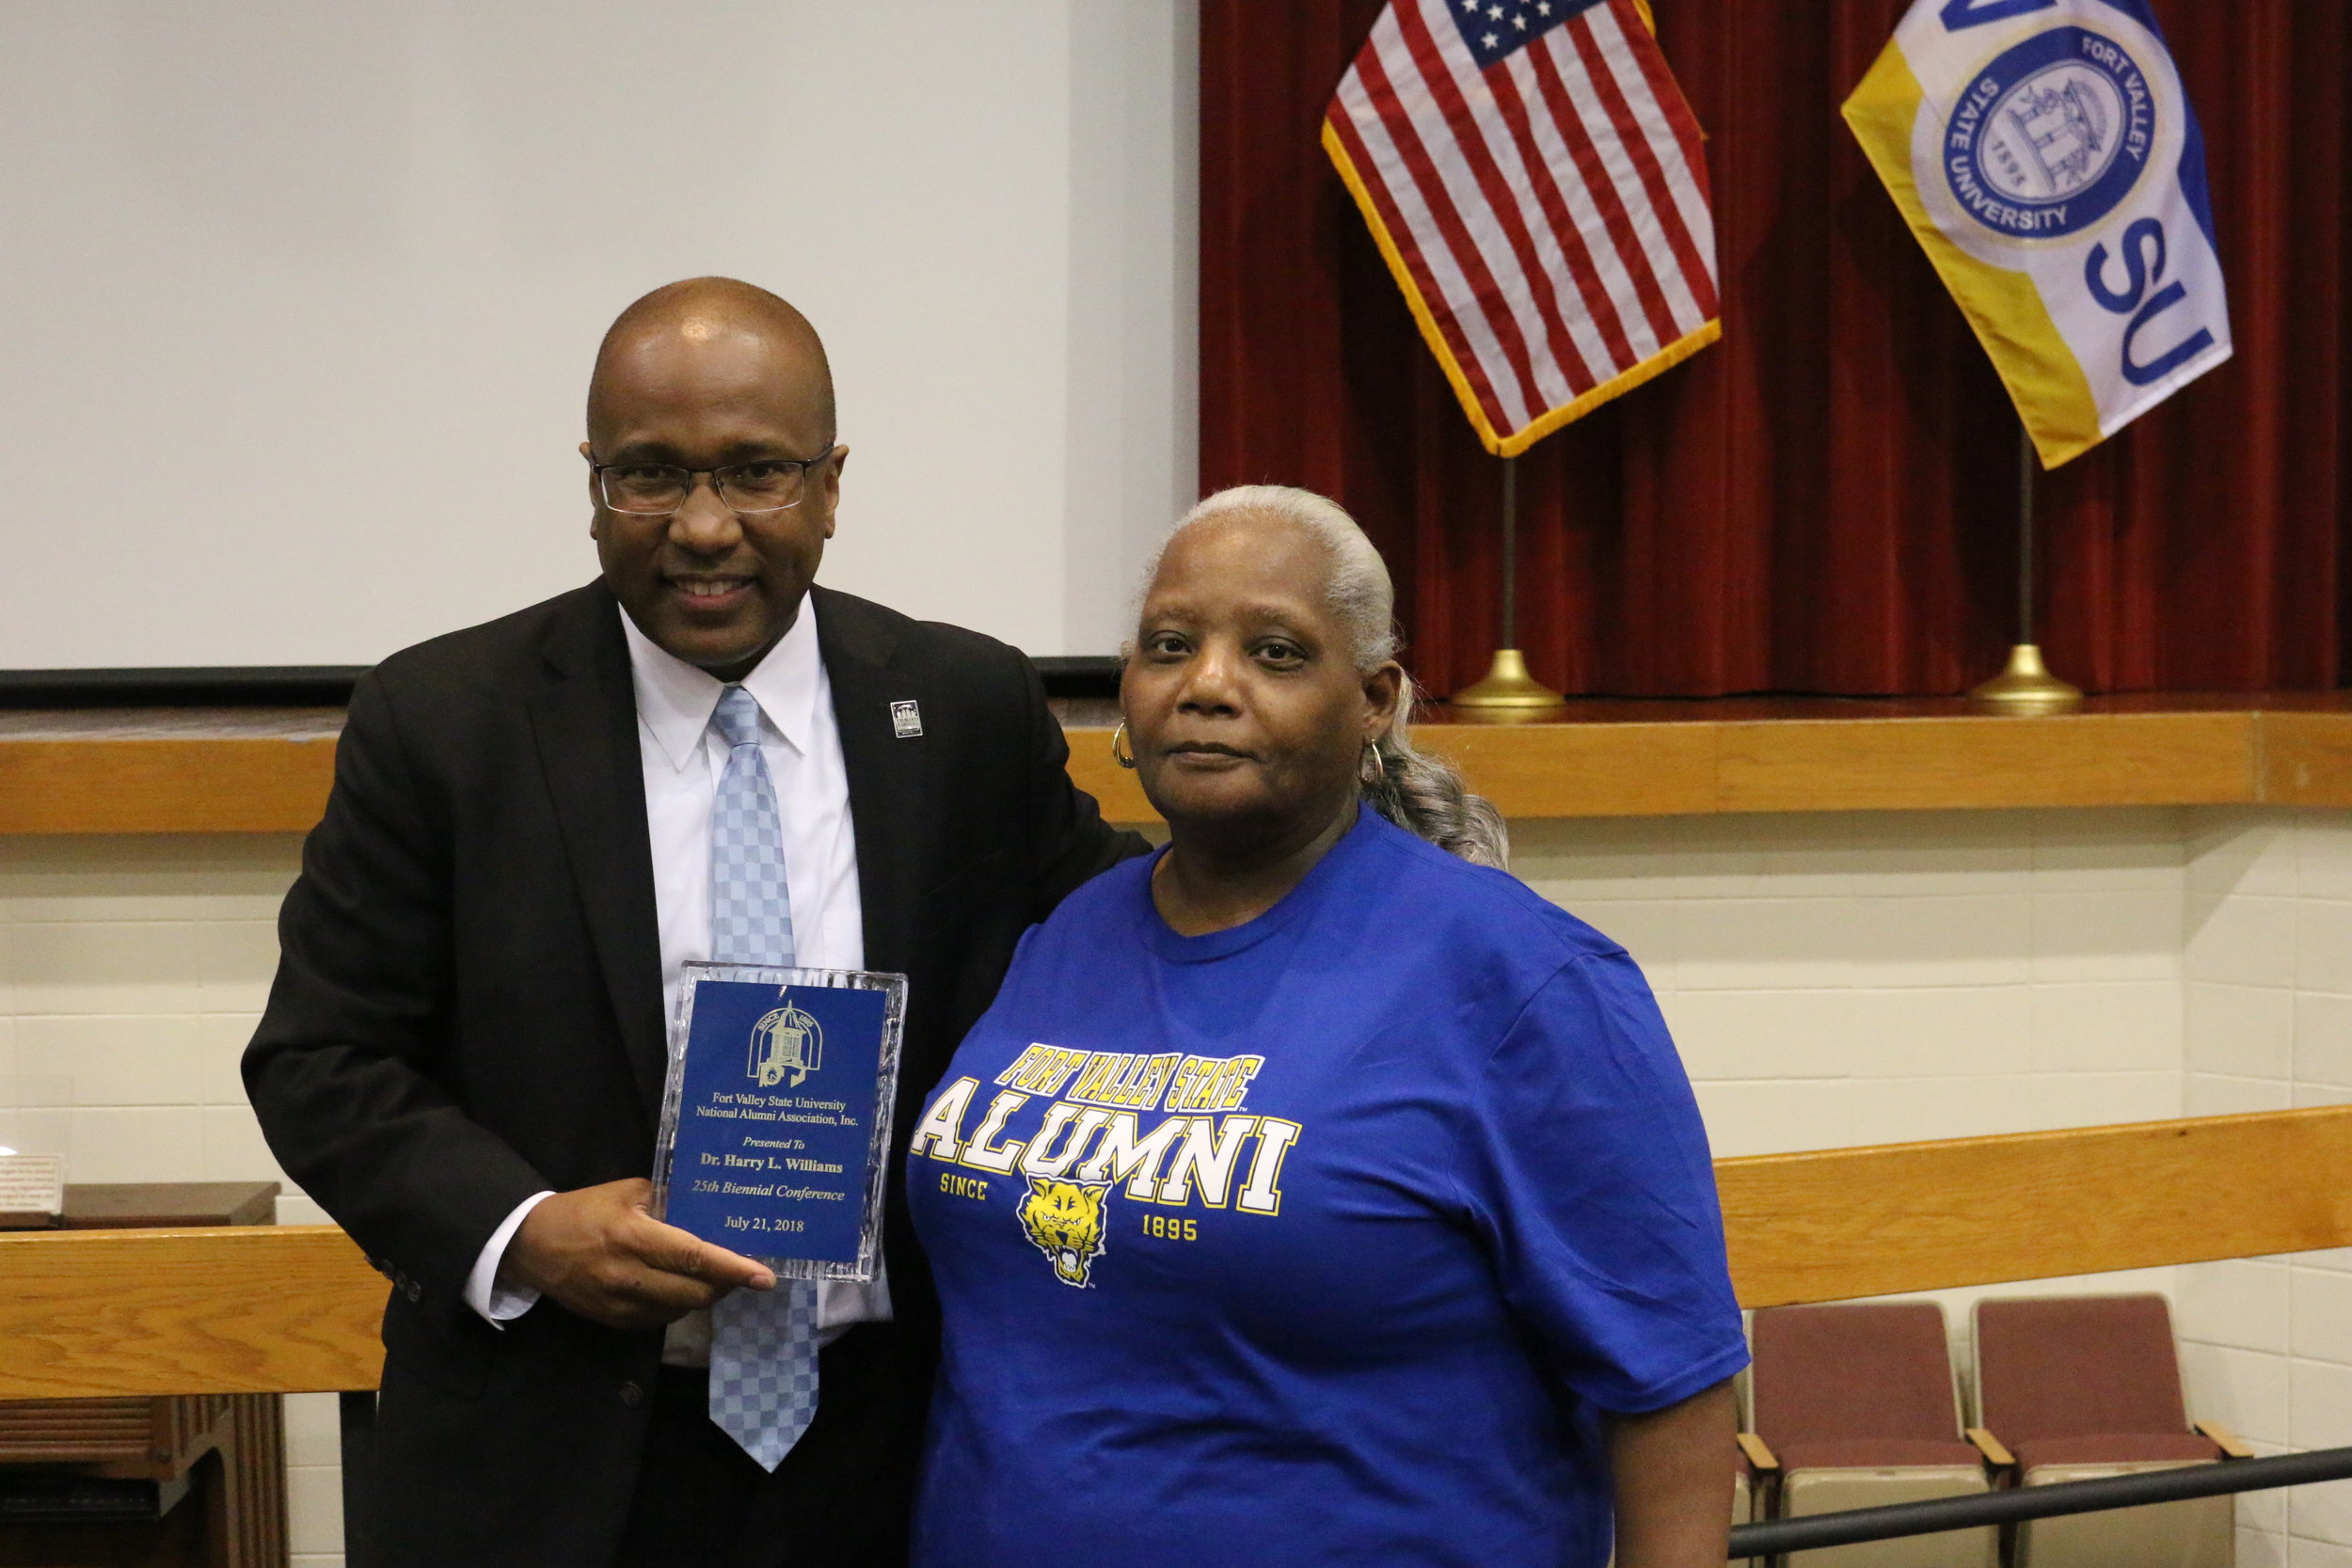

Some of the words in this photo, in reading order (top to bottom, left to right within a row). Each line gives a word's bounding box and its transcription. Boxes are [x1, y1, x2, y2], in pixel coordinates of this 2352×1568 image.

[2082, 37, 2129, 74] FORT
[2124, 72, 2148, 162] VALLEY
[1950, 77, 1999, 150] STATE
[1950, 156, 2068, 230] UNIVERSITY
[2085, 217, 2215, 387] SU
[757, 1013, 781, 1032] SINCE
[994, 1042, 1092, 1097] FORT
[1065, 1052, 1184, 1111] VALLEY
[1164, 1054, 1265, 1113] STATE
[696, 1106, 738, 1118] National
[739, 1109, 776, 1121] Alumni
[778, 1112, 837, 1126] Association,
[840, 1115, 859, 1126] Inc.
[712, 1092, 733, 1103] Fort
[736, 1094, 767, 1108] Valley
[768, 1096, 792, 1107] State
[795, 1098, 847, 1113] University
[742, 1136, 792, 1148] Presented
[794, 1139, 805, 1149] To
[910, 1076, 1302, 1216] ALUMNI
[701, 1152, 721, 1166] Dr.
[723, 1154, 765, 1171] Harry
[768, 1157, 782, 1170] L.
[786, 1158, 843, 1174] Williams
[692, 1180, 719, 1194] 25th
[722, 1182, 773, 1196] Biennial
[776, 1185, 845, 1201] Conference
[940, 1173, 988, 1200] SINCE
[724, 1216, 750, 1231] July
[753, 1218, 771, 1232] 21,
[774, 1219, 804, 1232] 2018
[1142, 1213, 1198, 1241] 1895
